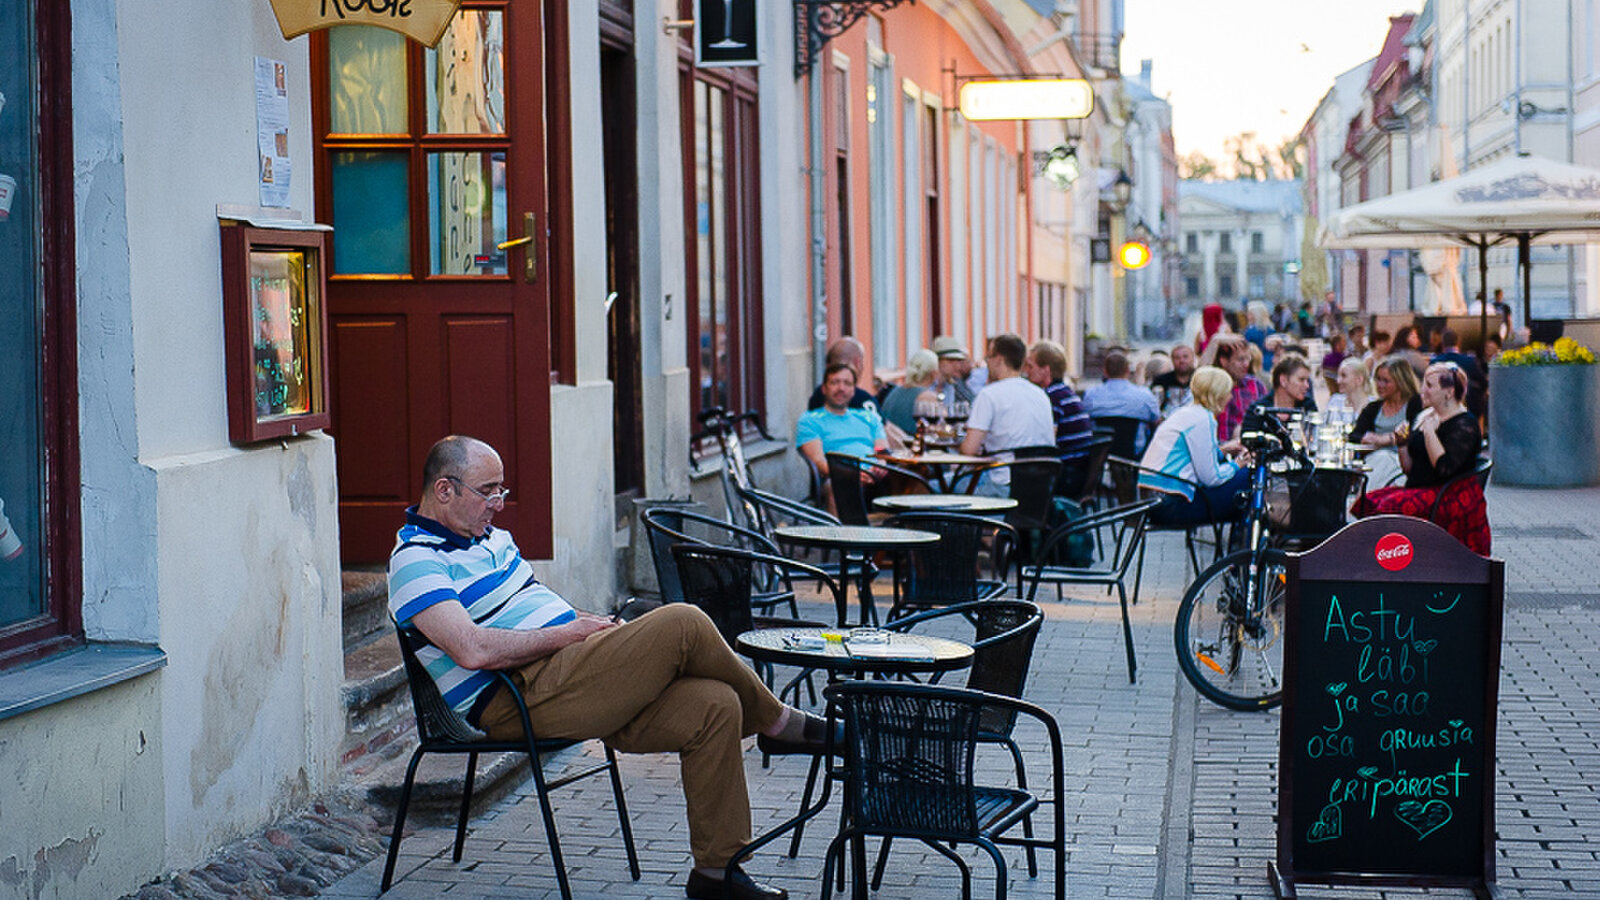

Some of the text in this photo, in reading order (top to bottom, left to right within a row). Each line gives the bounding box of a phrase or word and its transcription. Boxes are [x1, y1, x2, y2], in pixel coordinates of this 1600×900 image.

[1324, 593, 1415, 643] Astu
[1358, 642, 1433, 684] läbi
[1323, 684, 1430, 731] ja saa
[1308, 734, 1354, 758] osa
